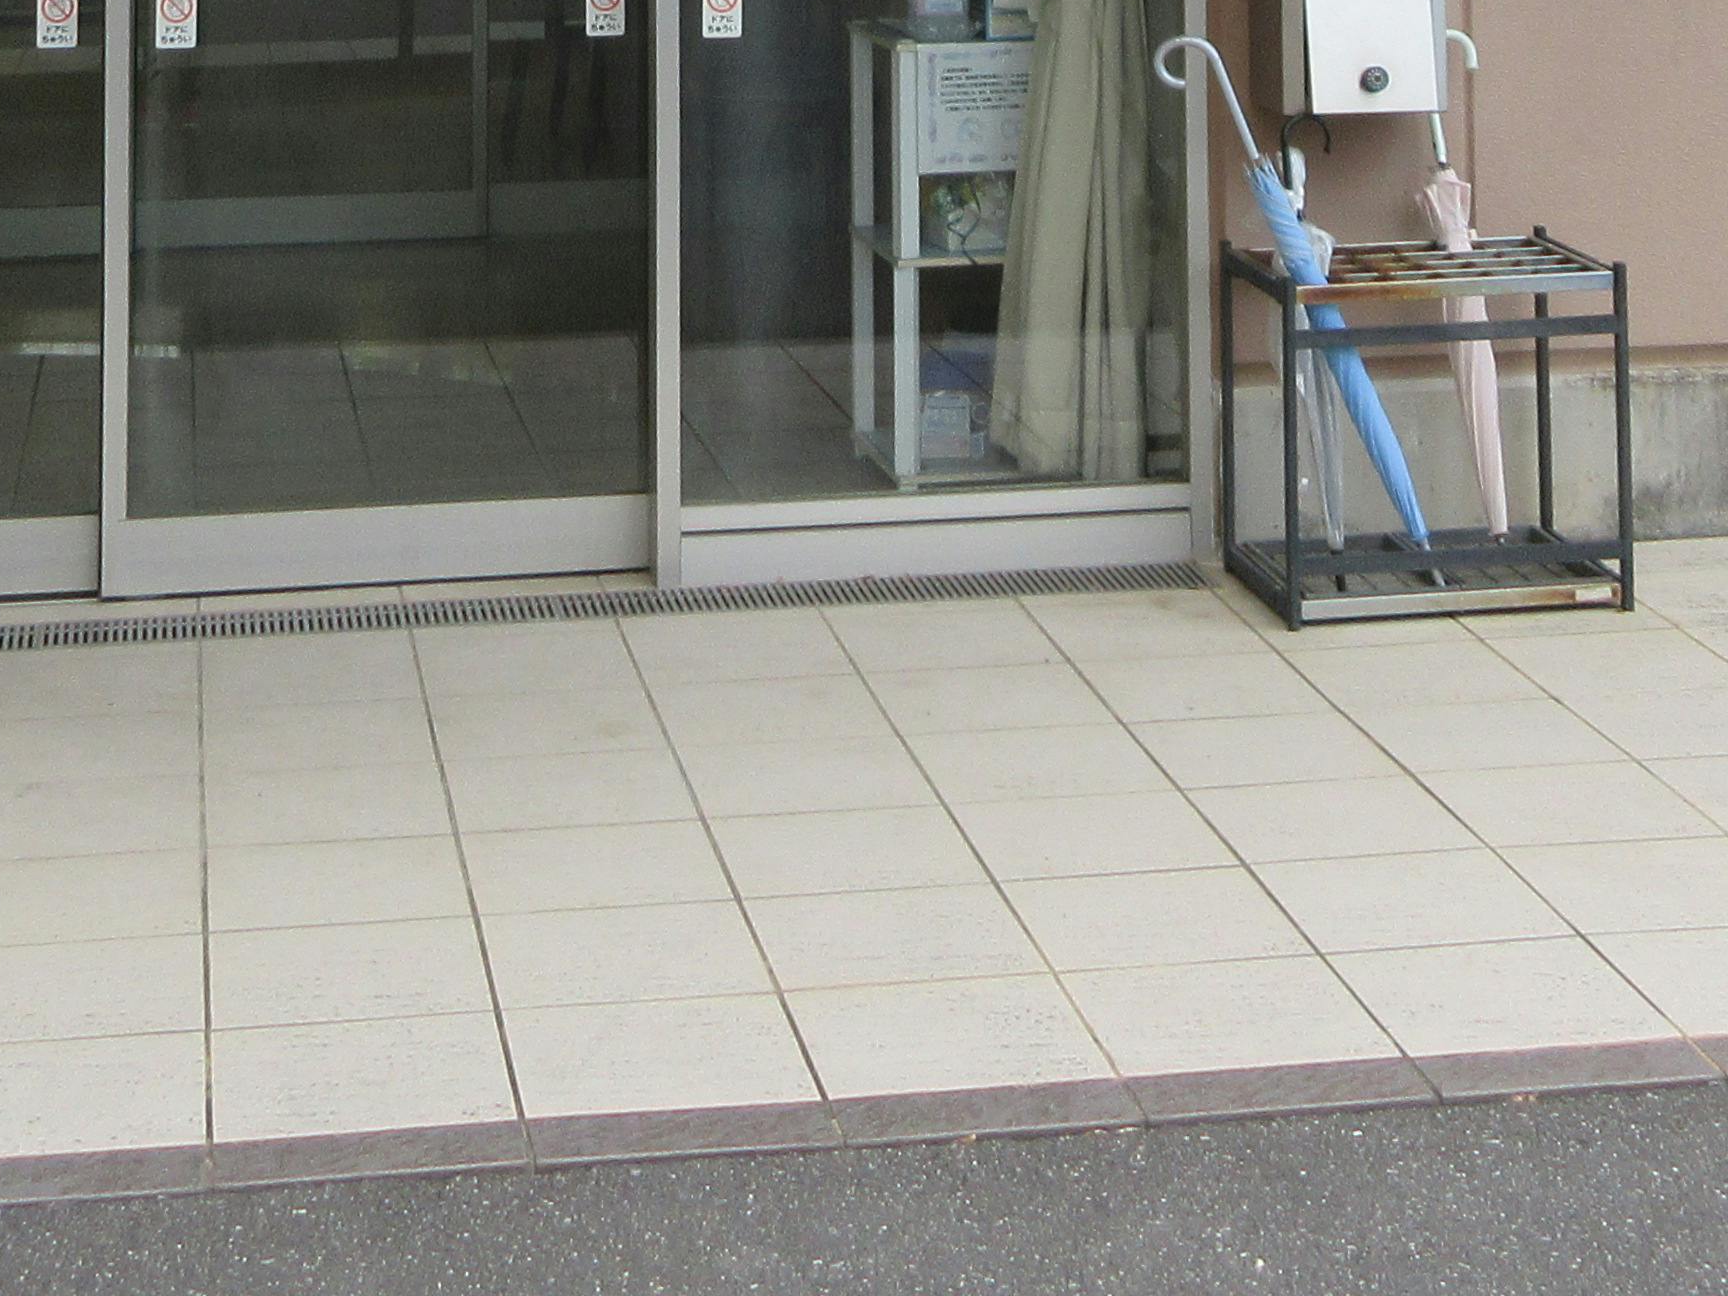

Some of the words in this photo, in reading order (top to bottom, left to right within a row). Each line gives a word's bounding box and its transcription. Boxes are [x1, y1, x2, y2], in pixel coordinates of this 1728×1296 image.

[595, 13, 617, 22] ドアに
[711, 15, 734, 23] ドアに
[46, 25, 69, 34] ドアに
[164, 25, 189, 34] ドアに
